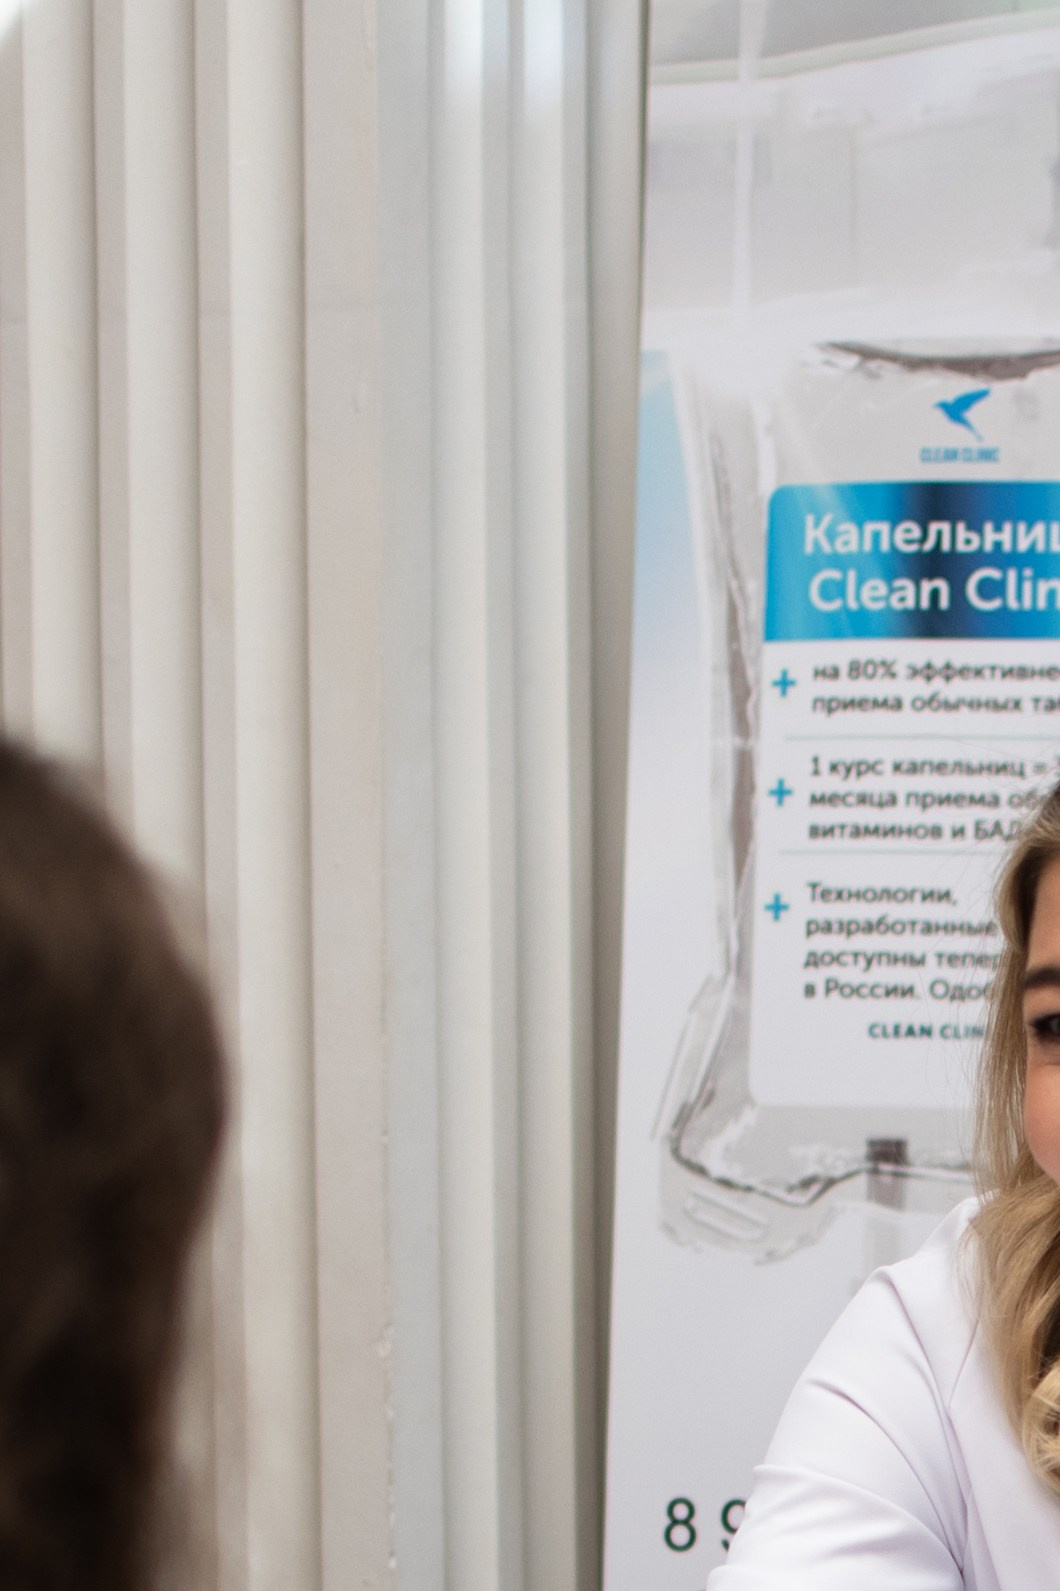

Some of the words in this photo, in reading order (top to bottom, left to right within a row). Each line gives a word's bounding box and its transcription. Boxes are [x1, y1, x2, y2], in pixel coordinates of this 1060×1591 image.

[808, 569, 949, 611] Clean
[813, 664, 840, 681] на
[848, 659, 898, 681] 80%
[812, 695, 903, 716] приема
[911, 690, 1023, 713] обычных
[810, 756, 821, 776] 1
[828, 760, 884, 780] курс
[892, 760, 1026, 779] капельниц
[809, 791, 898, 811] месяца
[906, 792, 1000, 812] приема
[808, 822, 943, 840] витаминов
[951, 823, 966, 840] и
[806, 881, 957, 906] Технологии,
[805, 914, 999, 939] разработанные
[803, 950, 927, 972] доступны
[804, 982, 816, 999] в
[824, 977, 922, 999] России.
[867, 1022, 933, 1041] CLEAN
[663, 1497, 697, 1552] 8
